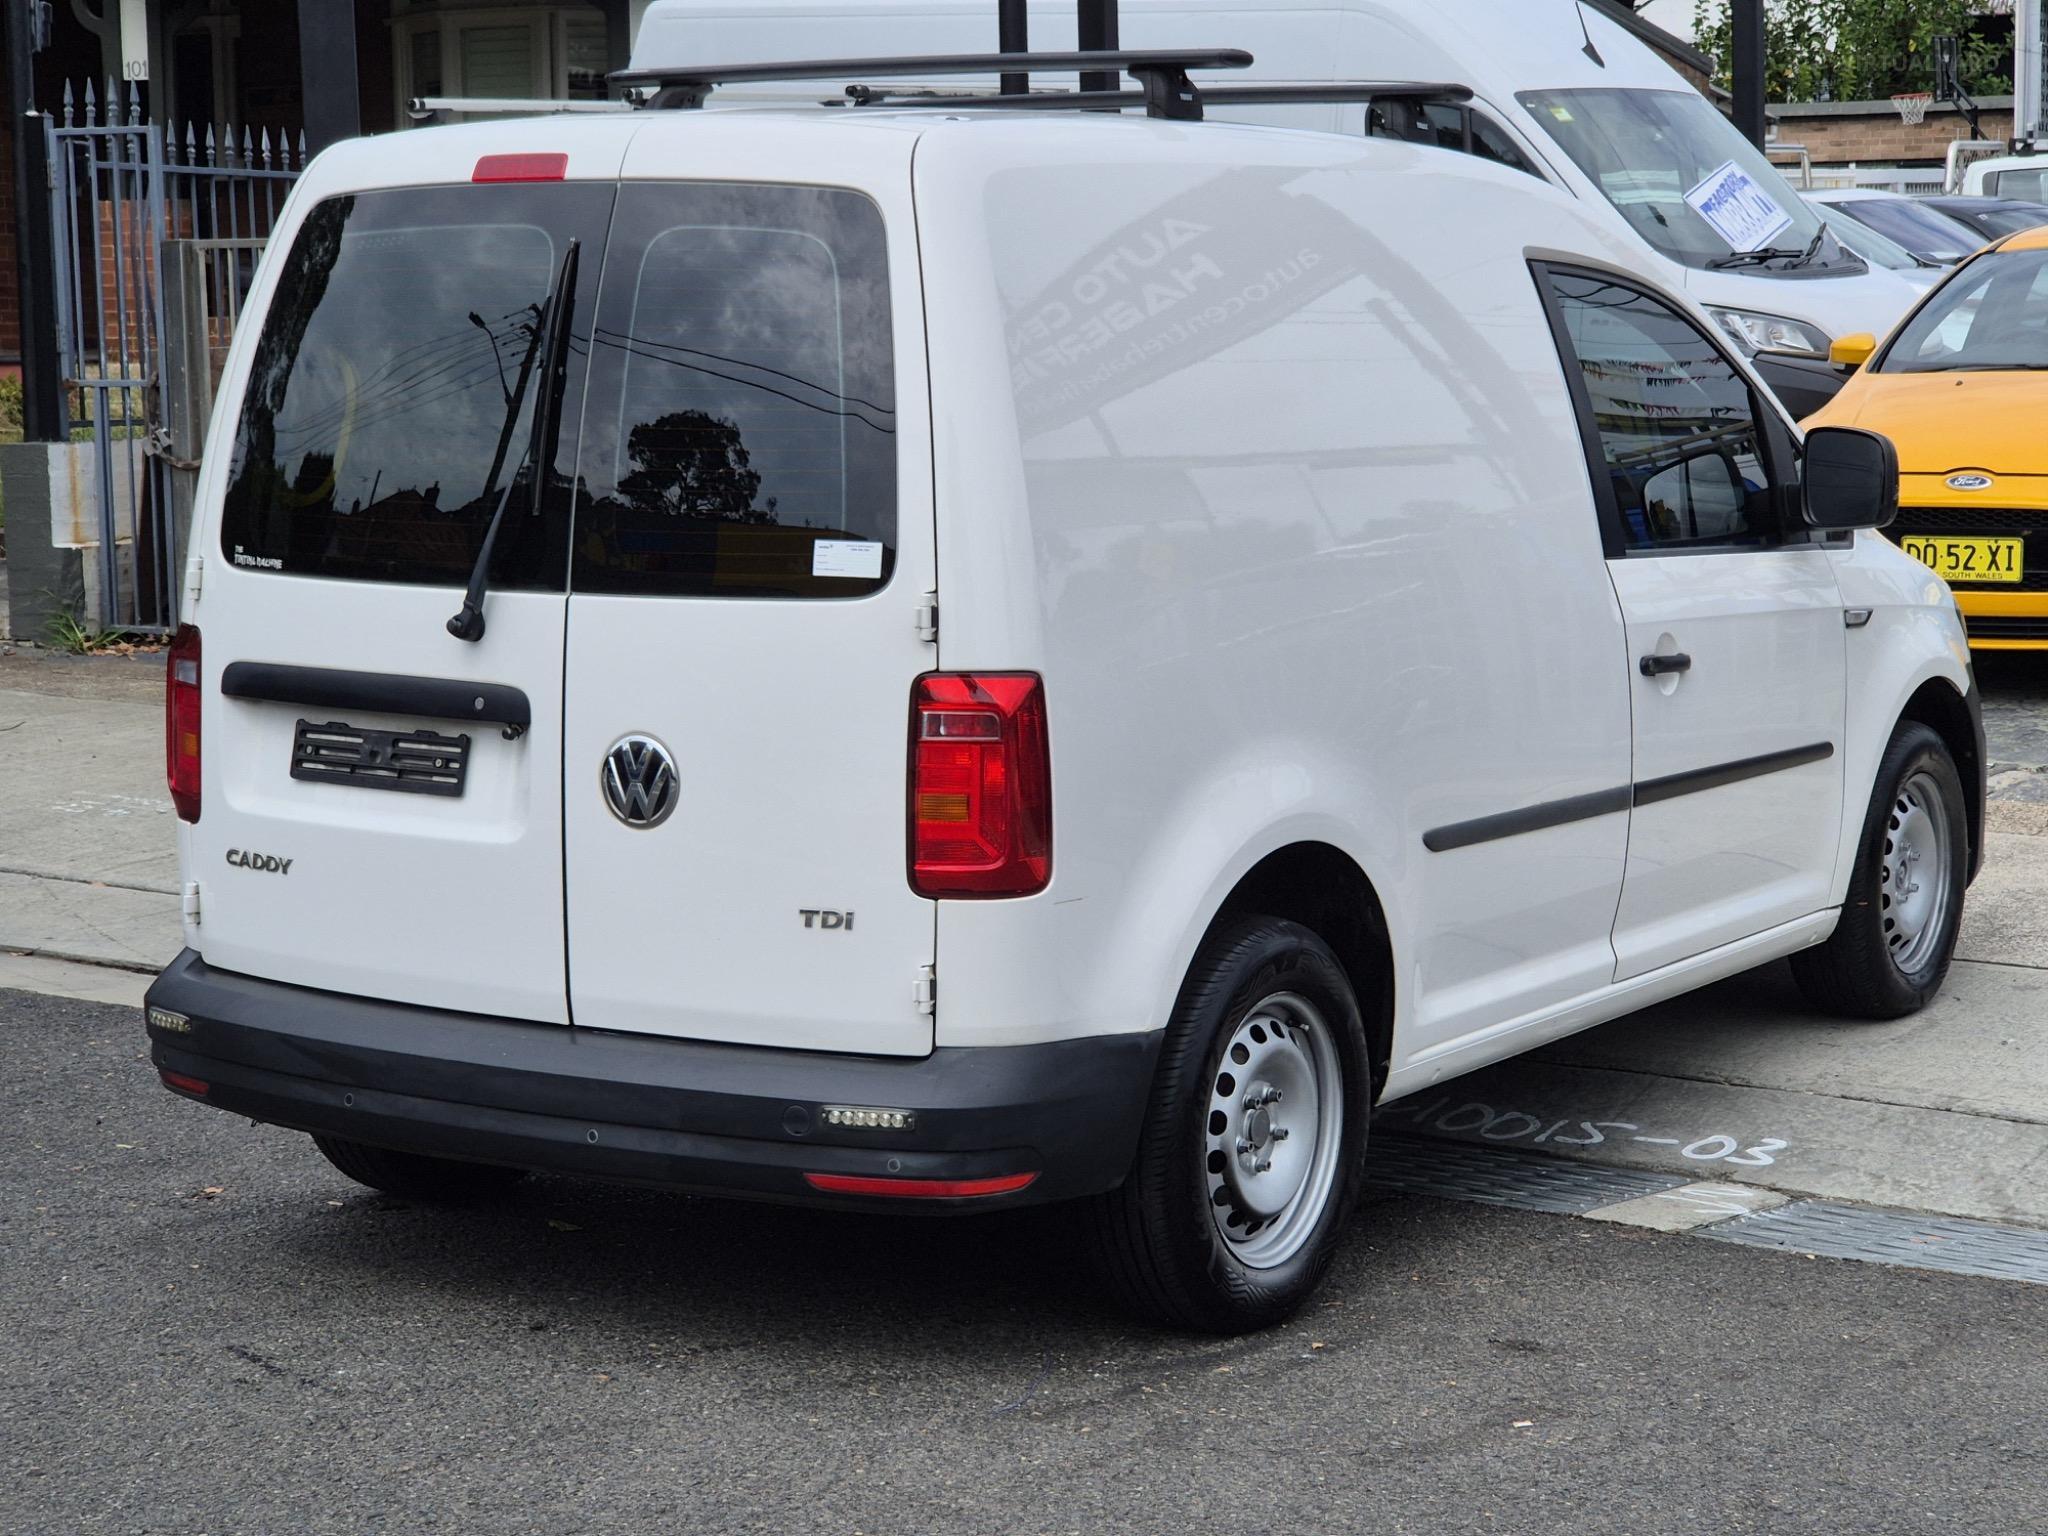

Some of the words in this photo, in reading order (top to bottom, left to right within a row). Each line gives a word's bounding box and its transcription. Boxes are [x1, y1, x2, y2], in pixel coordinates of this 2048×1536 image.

[125, 60, 147, 78] 101
[1953, 476, 1983, 488] Ford
[1942, 570, 1971, 579] SOUTH
[1975, 571, 2004, 580] WALES
[226, 849, 294, 875] CADDY
